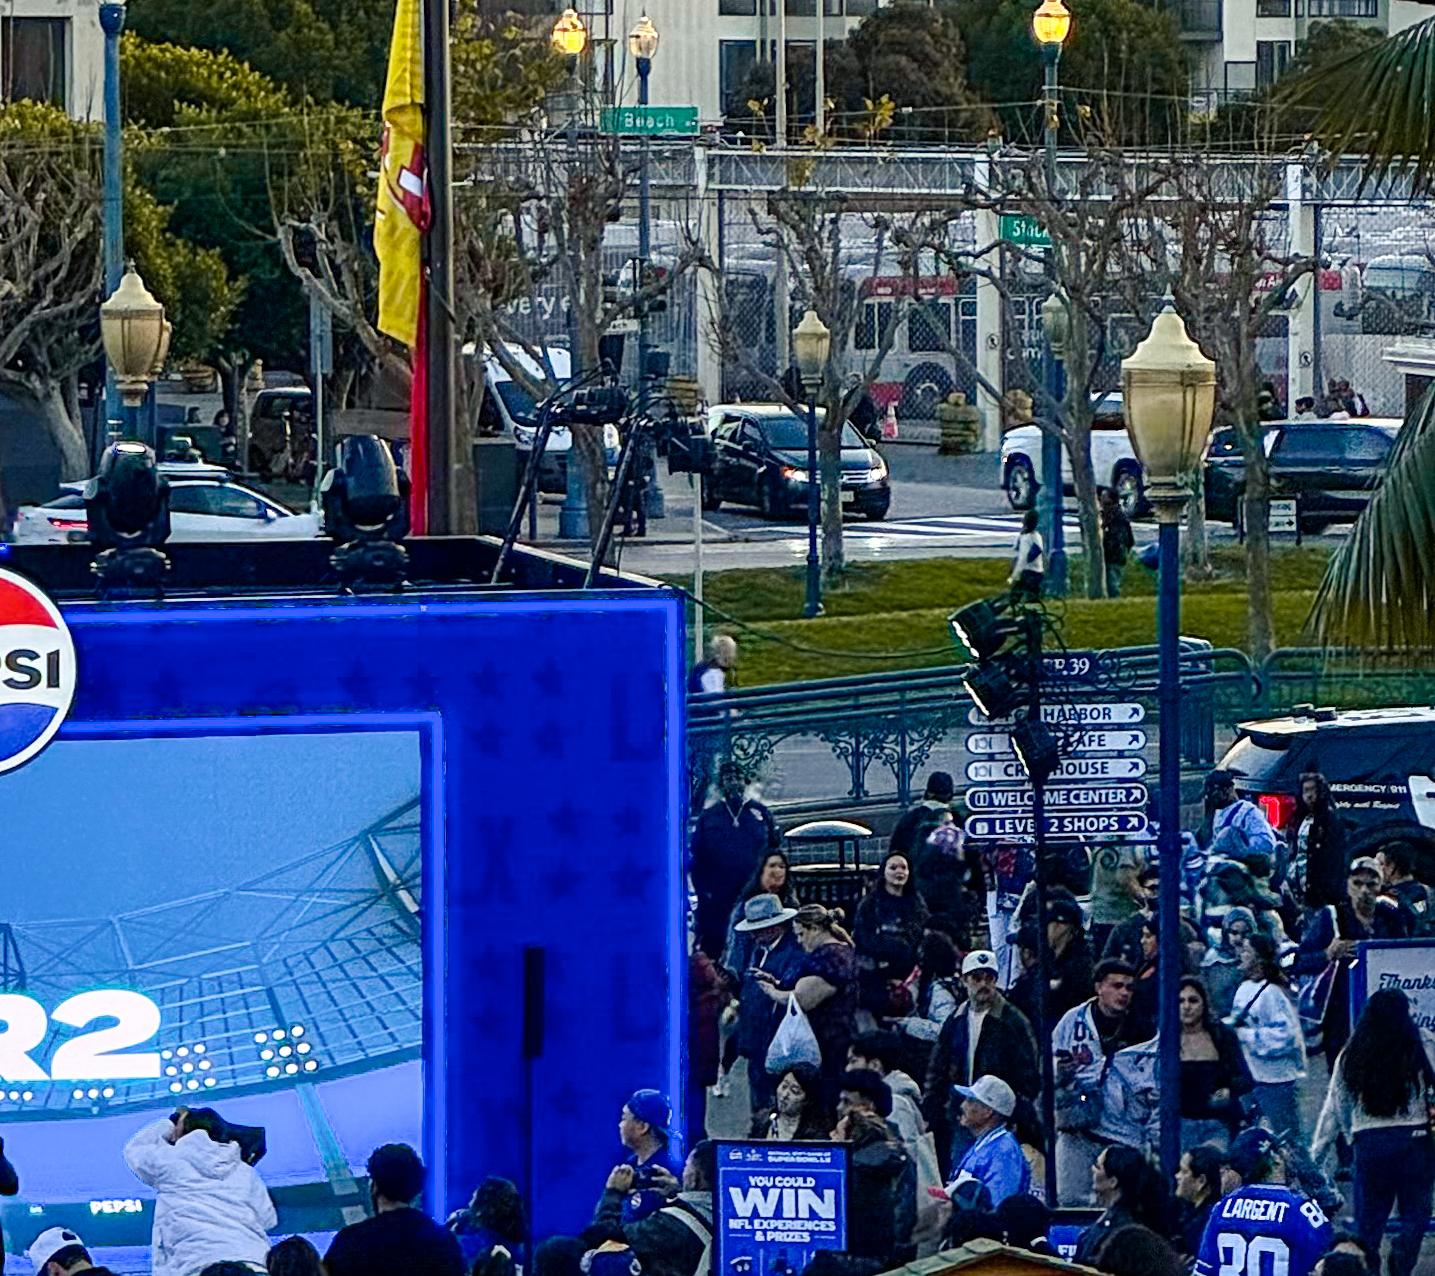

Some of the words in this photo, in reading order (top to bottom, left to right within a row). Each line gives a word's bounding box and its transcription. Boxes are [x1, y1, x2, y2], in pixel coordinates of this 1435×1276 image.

[625, 112, 675, 129] Beach
[992, 792, 1069, 807] WELCME
[1069, 790, 1127, 805] CENTER
[995, 819, 1035, 833] LEVE
[1049, 820, 1059, 832] 2
[1063, 817, 1119, 832] SHOPS
[1380, 972, 1435, 990] Thank
[748, 1176, 774, 1187] YOU
[774, 1176, 816, 1188] COULD
[90, 1199, 142, 1215] PEPSI
[728, 1187, 835, 1219] WIN
[1222, 1198, 1290, 1223] LARGENT
[728, 1218, 753, 1230] NFL
[753, 1219, 837, 1232] EXPERIENCES
[754, 1230, 766, 1242] &
[766, 1231, 811, 1243] PRIZES
